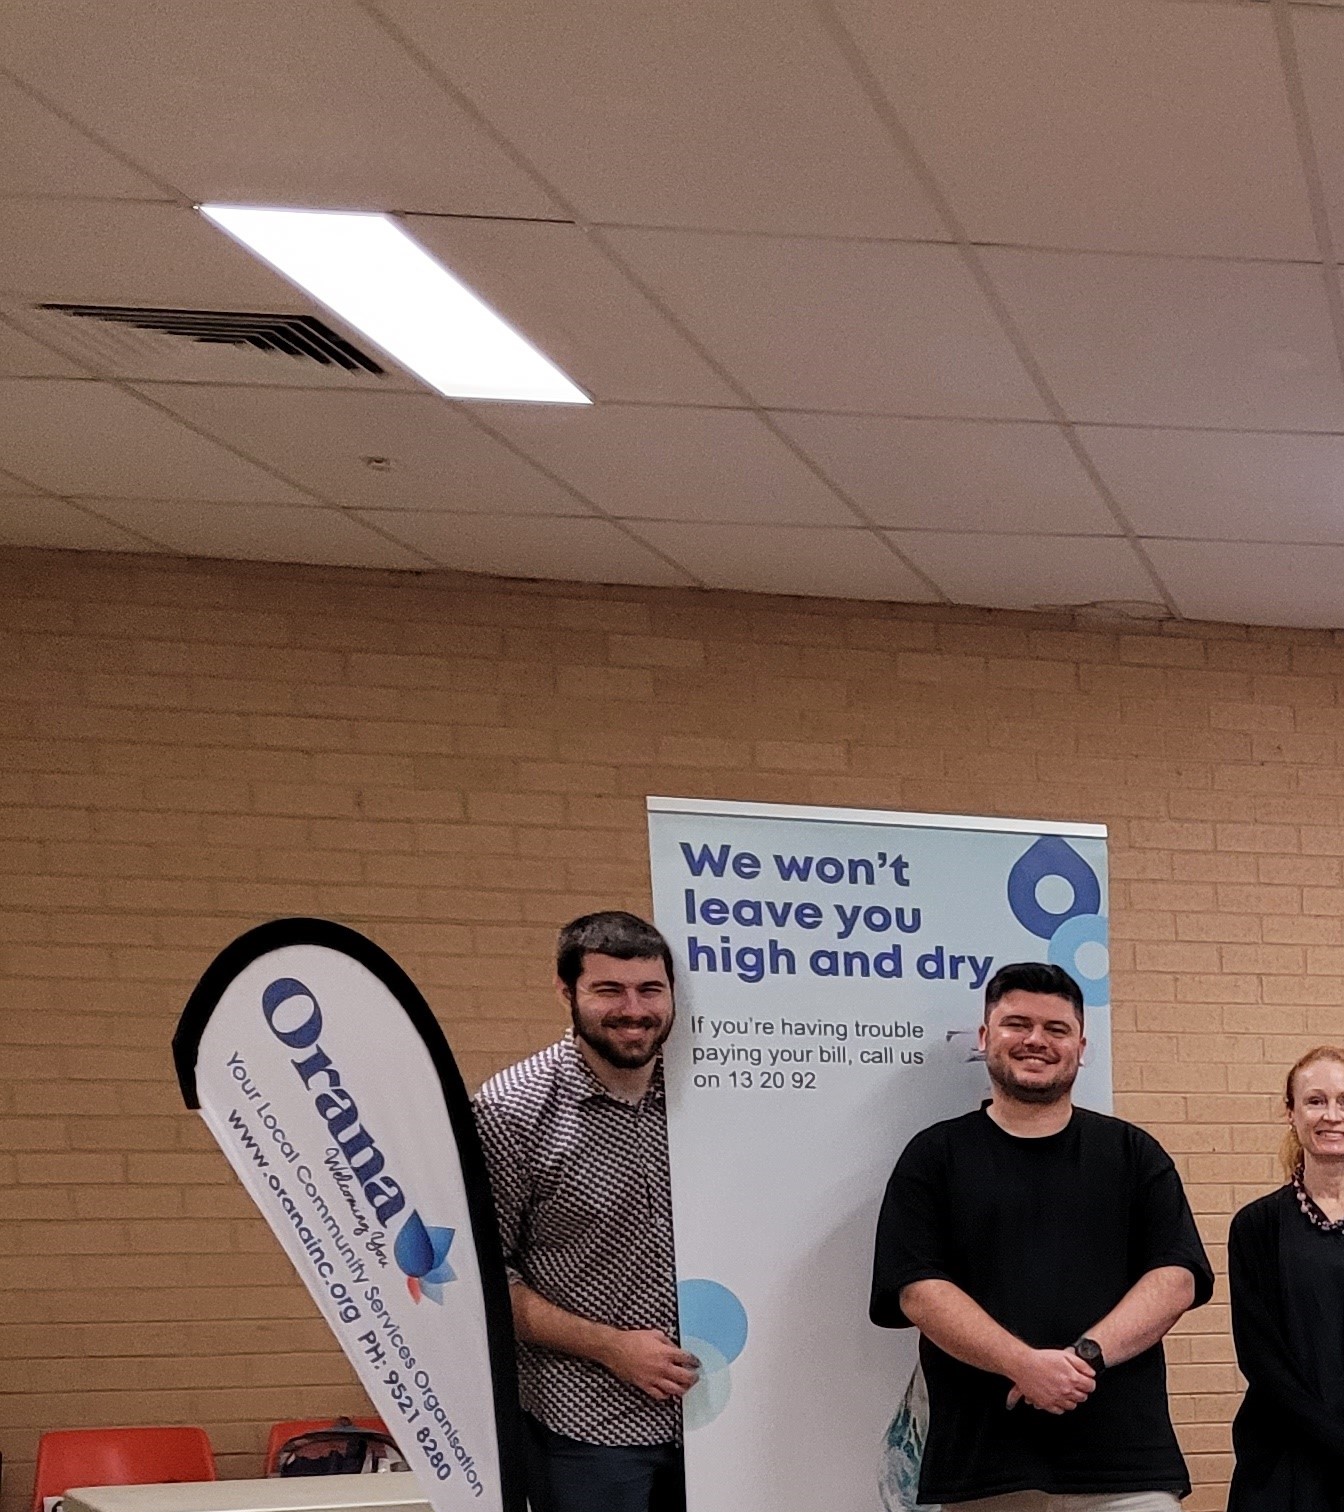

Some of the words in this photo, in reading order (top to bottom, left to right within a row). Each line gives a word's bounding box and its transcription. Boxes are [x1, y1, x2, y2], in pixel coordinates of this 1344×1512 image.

[679, 841, 761, 880] We
[772, 851, 910, 887] won't
[684, 888, 823, 929] leave
[833, 903, 922, 939] you
[687, 936, 796, 983] high
[809, 944, 903, 978] and
[916, 945, 994, 990] dry
[691, 1015, 704, 1034] If
[710, 1016, 775, 1039] you're
[781, 1018, 848, 1041] having
[854, 1020, 924, 1040] trouble
[692, 1046, 762, 1066] paying
[769, 1047, 813, 1067] your
[819, 1046, 852, 1066] bill,
[859, 1046, 894, 1064] call
[900, 1050, 924, 1066] us
[693, 1073, 720, 1088] on
[728, 1071, 753, 1088] 13
[760, 1071, 785, 1089] 20
[791, 1071, 817, 1089] 92
[262, 978, 406, 1228] Orana
[324, 1148, 370, 1236] Welcoming
[366, 1231, 388, 1268] You
[226, 1051, 262, 1100] Your
[256, 1102, 300, 1163] Local
[297, 1165, 370, 1283] Community
[364, 1286, 416, 1370] Services
[414, 1370, 484, 1498] Organisation
[228, 1109, 361, 1324] www.oranainc.org
[358, 1330, 387, 1370] PH:
[383, 1370, 420, 1424] 9521
[416, 1427, 451, 1481] 8280
